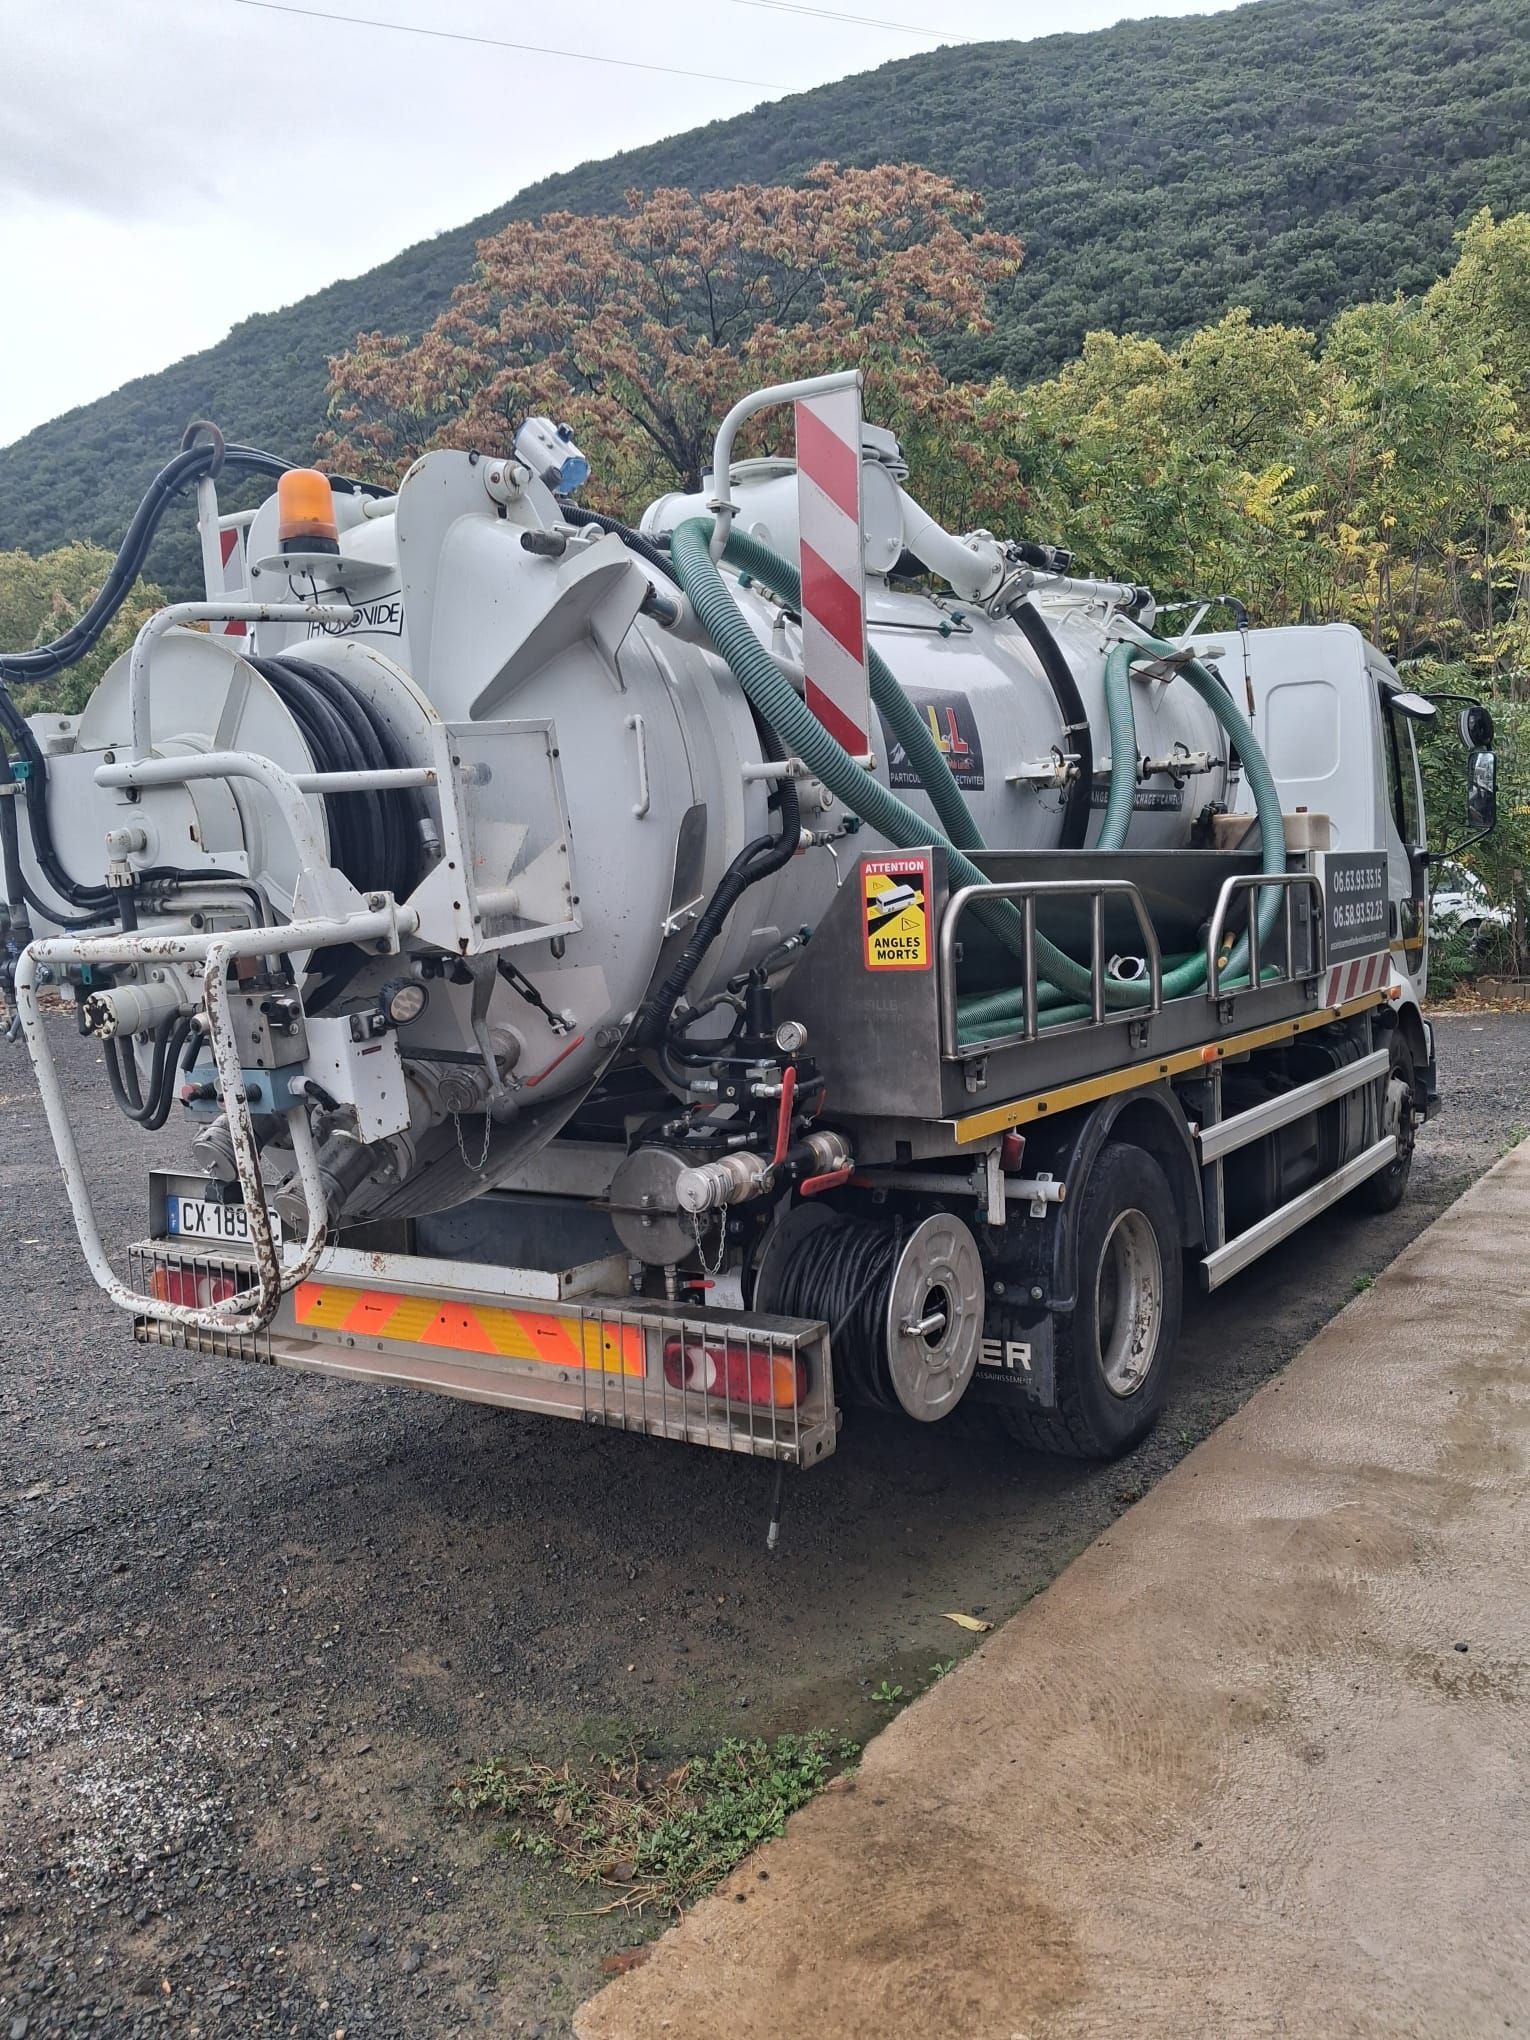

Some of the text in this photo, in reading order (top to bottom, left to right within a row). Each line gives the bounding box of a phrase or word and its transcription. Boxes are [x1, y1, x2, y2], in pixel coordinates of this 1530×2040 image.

[890, 772, 922, 785] PARTICUL
[865, 861, 925, 874] ATTENTION
[1333, 867, 1383, 894] 06.63.93.35.15
[1333, 899, 1384, 929] 06.58.93.52.23
[874, 936, 921, 949] ANGLES
[877, 949, 919, 961] MORTS
[979, 1338, 1032, 1371] ER
